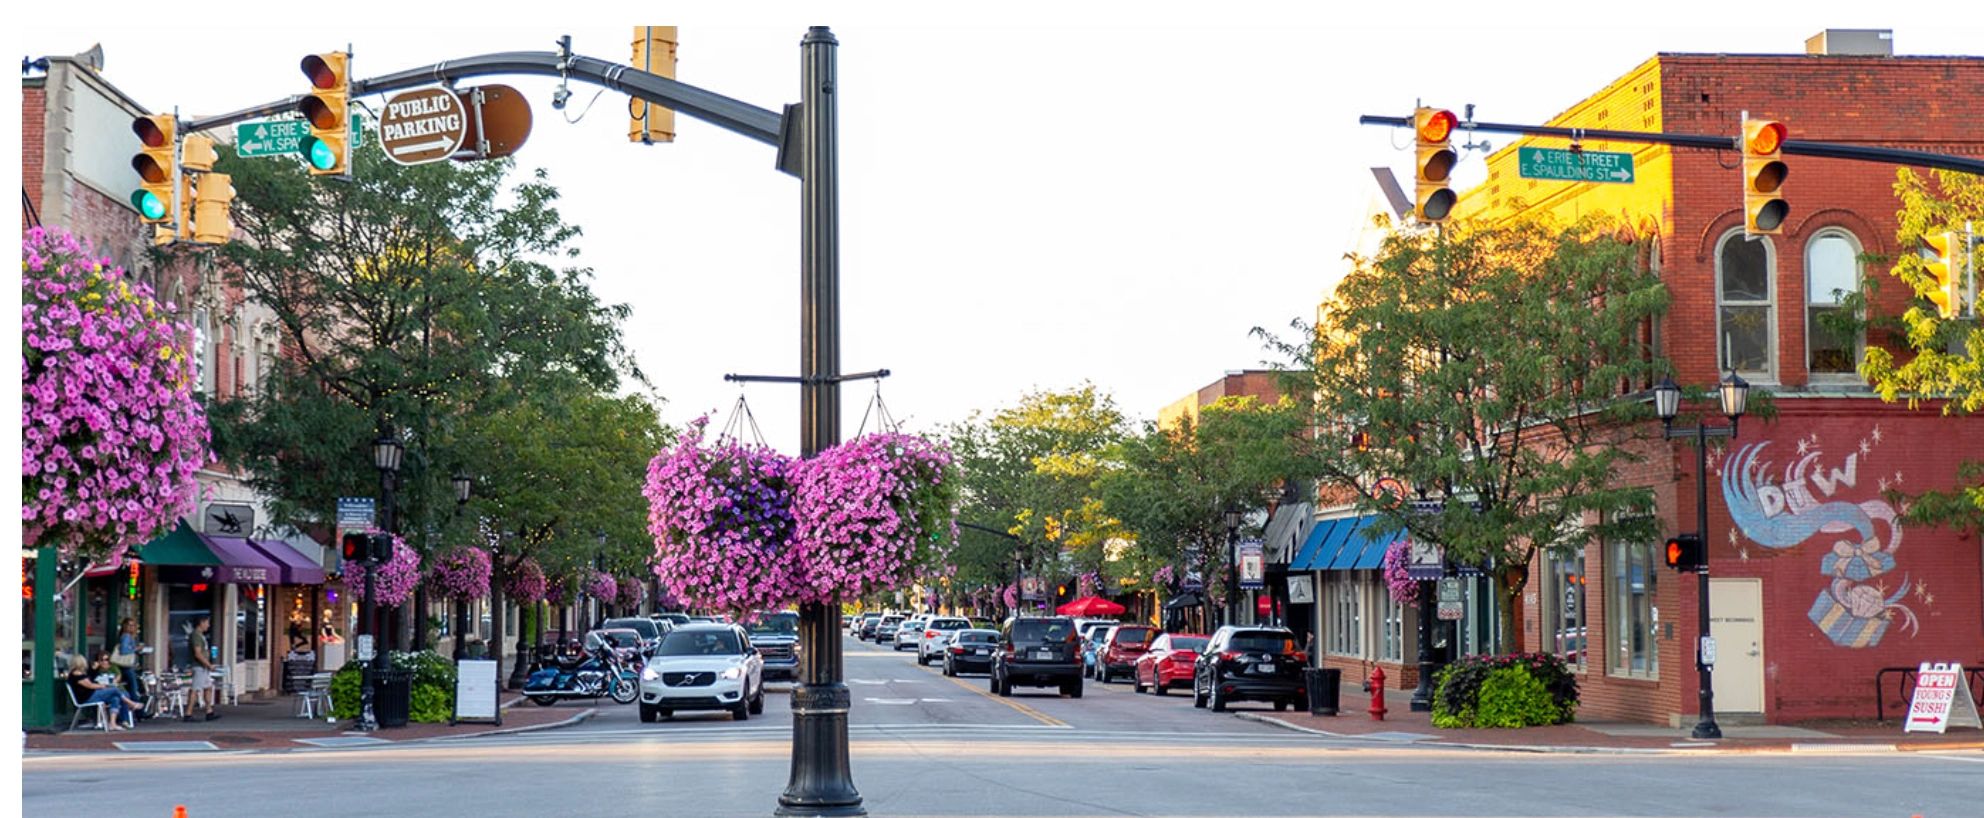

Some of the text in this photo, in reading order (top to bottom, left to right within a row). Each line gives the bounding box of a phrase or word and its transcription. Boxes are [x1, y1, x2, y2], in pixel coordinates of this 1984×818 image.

[388, 95, 451, 120] PUBLIC
[271, 123, 298, 138] ERIE
[383, 114, 460, 141] PARKING
[279, 138, 300, 151] SPA
[1547, 151, 1620, 168] ERIE STREET
[1533, 164, 1594, 180] SPAULDING
[1757, 452, 1857, 518] DTW
[1919, 674, 1955, 688] OPEN
[1913, 701, 1947, 714] SUSHI
